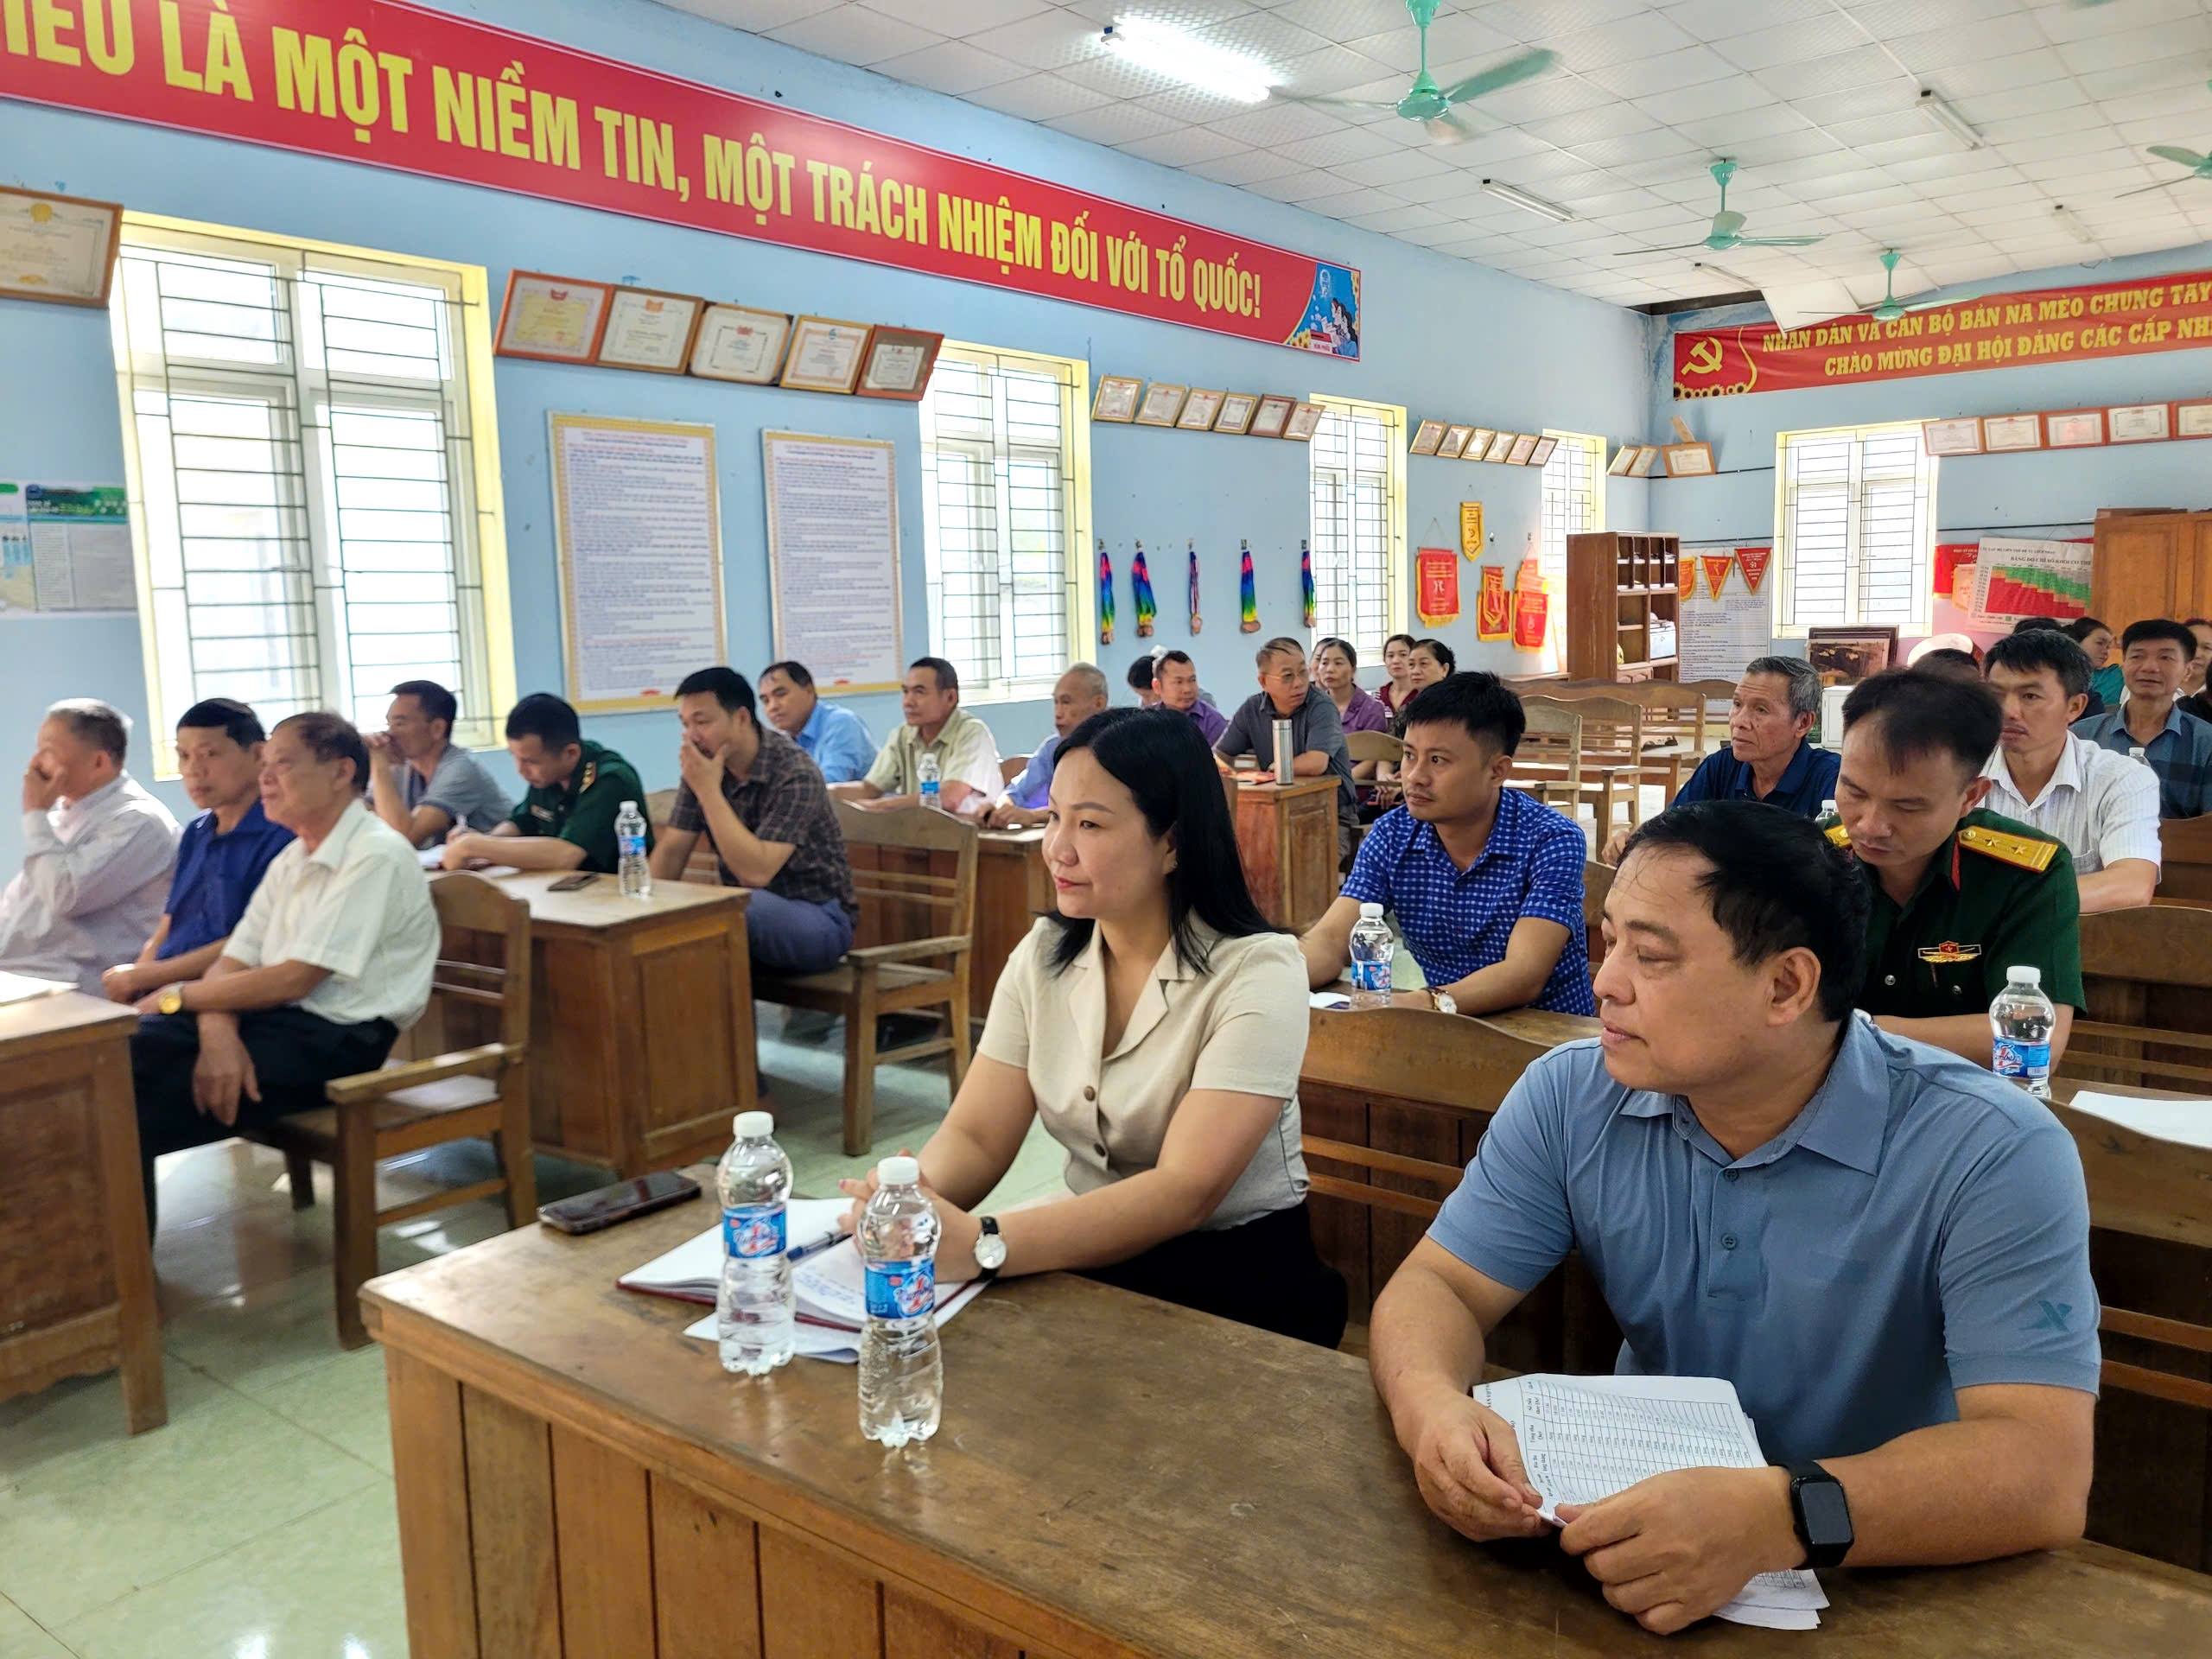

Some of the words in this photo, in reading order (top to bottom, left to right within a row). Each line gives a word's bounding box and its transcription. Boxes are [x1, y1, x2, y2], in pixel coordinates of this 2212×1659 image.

[159, 0, 253, 101] LÀ
[273, 27, 413, 143] MỘT
[433, 61, 582, 169] NIỀM
[594, 106, 690, 202] TIN,
[703, 134, 795, 226] MỘT
[807, 160, 928, 245] TRÁCH
[938, 195, 1043, 275] NHIỆM
[1050, 210, 1099, 283] ĐỐI
[1106, 230, 1149, 294] VỚI
[1155, 234, 1187, 302] TỔ
[1192, 251, 1262, 319] QUỐC!
[1815, 322, 1853, 346] DÂN
[1929, 308, 1955, 336] BỘ
[1959, 303, 2000, 330] BẢN
[2005, 302, 2033, 325] NA
[2089, 286, 2164, 315] CHUNG
[2171, 281, 2212, 305] TAY
[1825, 350, 1873, 377] CHÀO
[1937, 342, 1972, 367] ĐẠI
[1976, 334, 2012, 363] HỘI
[2017, 328, 2074, 356] ĐẢNG
[2080, 322, 2122, 349] CÁC
[2128, 314, 2171, 344] CẤP
[2177, 316, 2212, 340] NH
